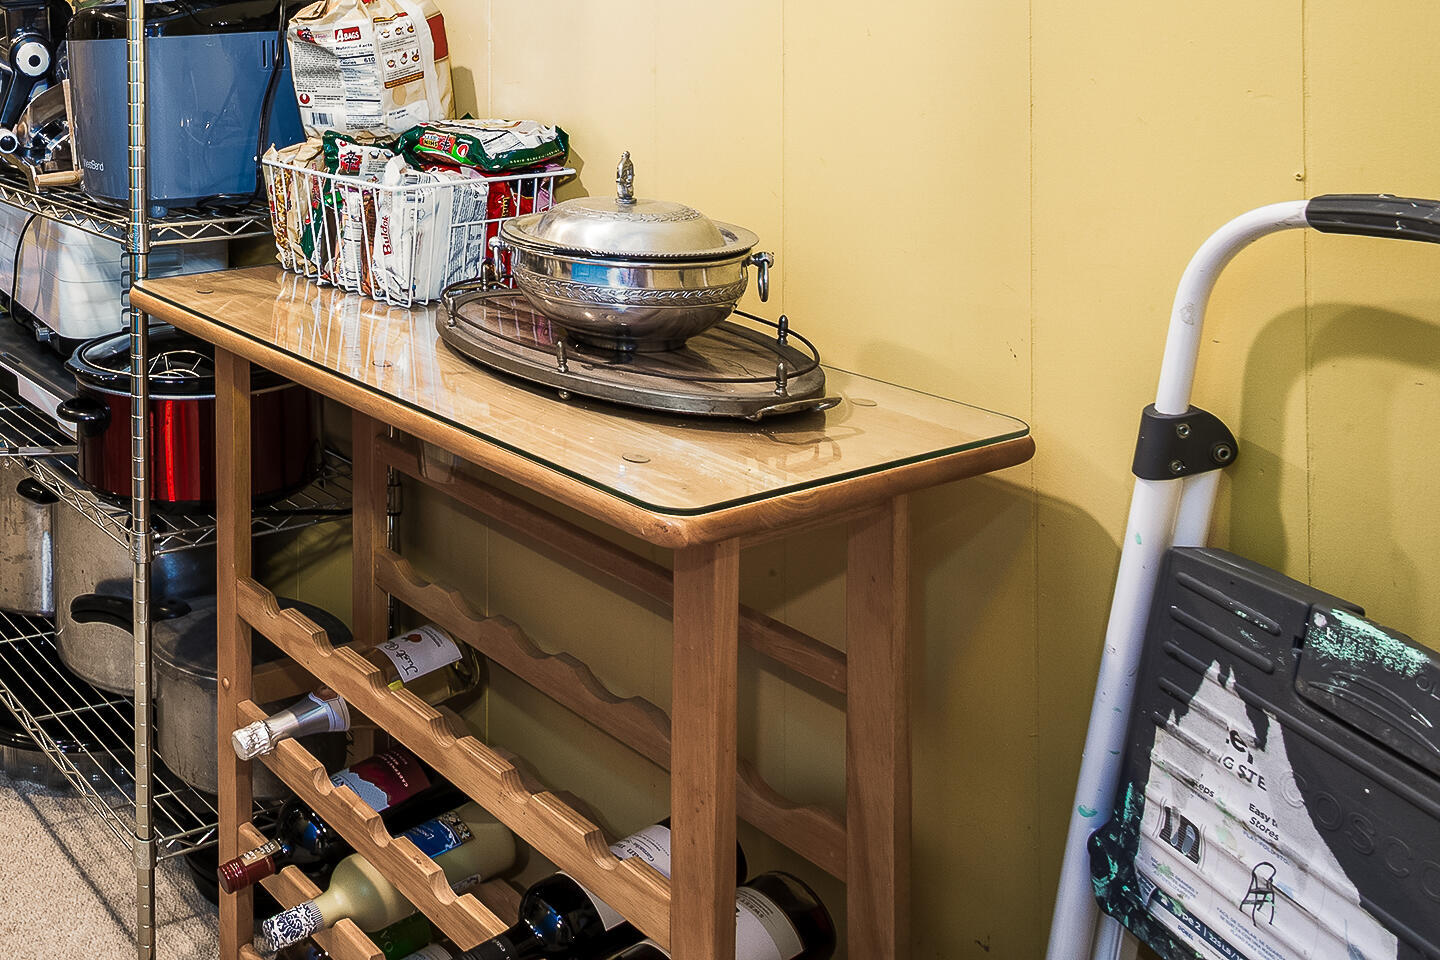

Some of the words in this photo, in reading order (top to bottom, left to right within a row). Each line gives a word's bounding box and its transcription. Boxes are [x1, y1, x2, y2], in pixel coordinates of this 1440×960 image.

[343, 31, 360, 40] BAGS
[381, 215, 392, 256] Buldak
[396, 649, 419, 676] Just
[1238, 764, 1268, 791] STE
[1249, 803, 1270, 824] Easy
[1250, 817, 1280, 841] Stores
